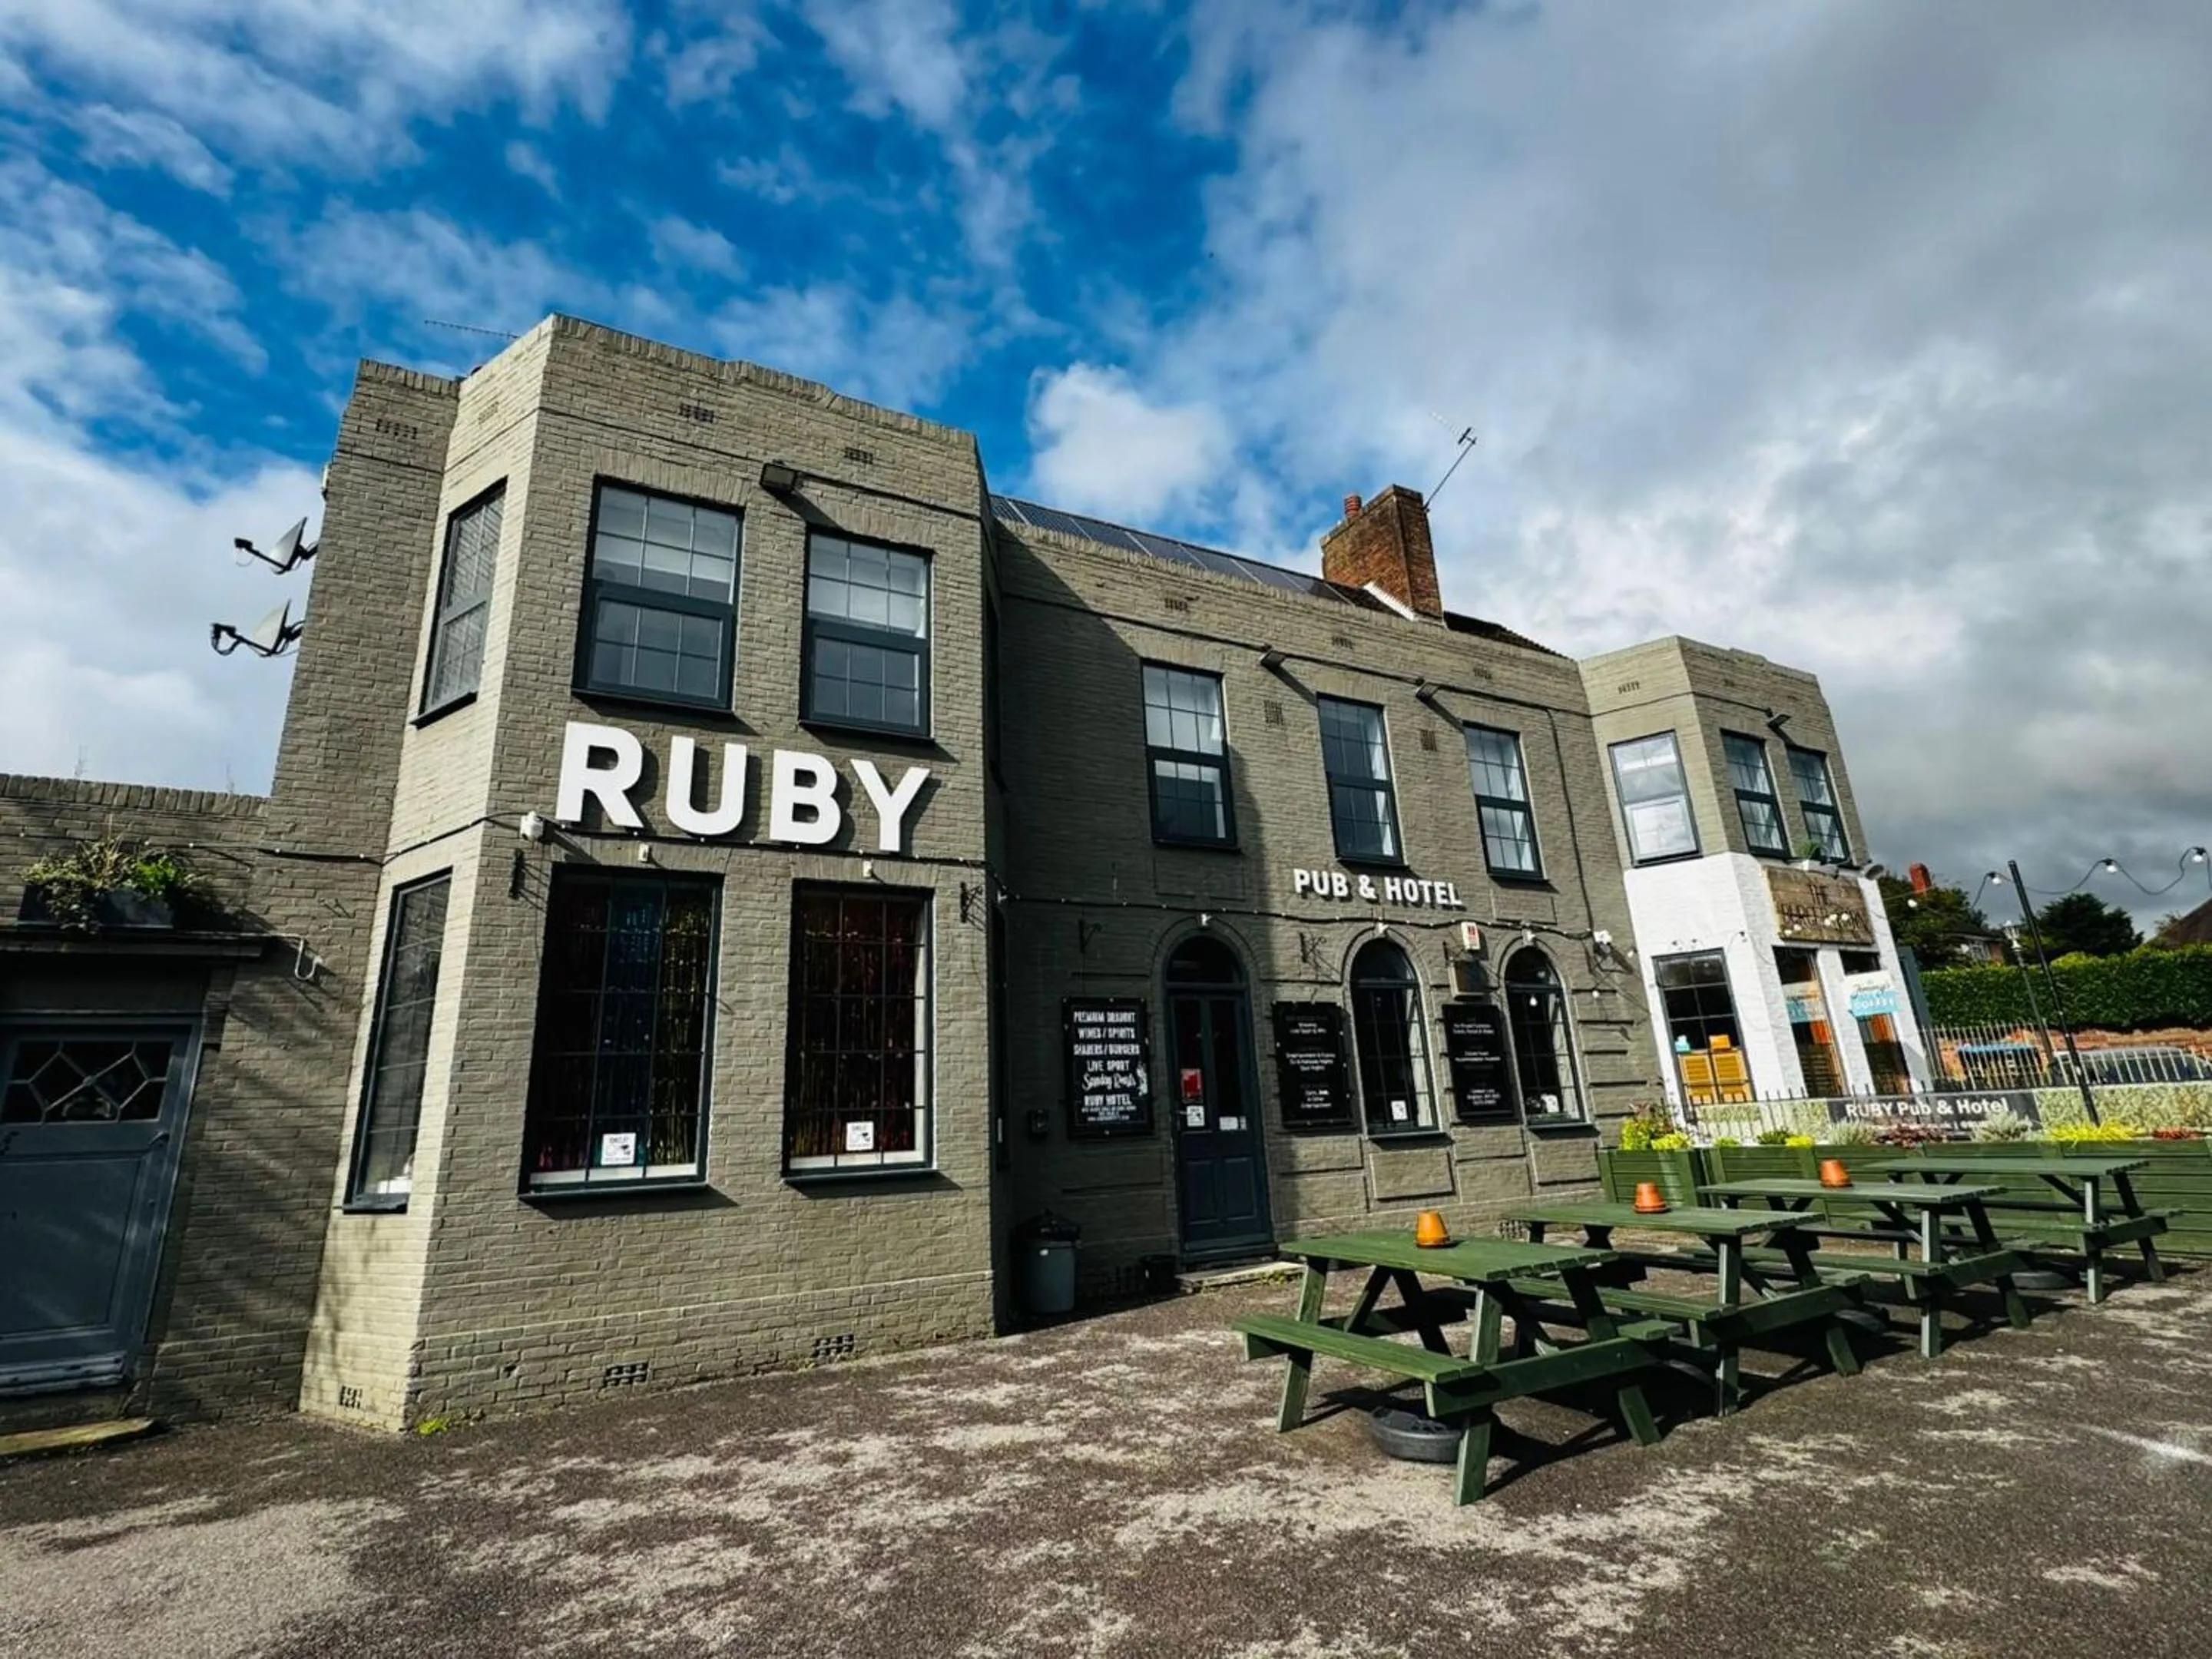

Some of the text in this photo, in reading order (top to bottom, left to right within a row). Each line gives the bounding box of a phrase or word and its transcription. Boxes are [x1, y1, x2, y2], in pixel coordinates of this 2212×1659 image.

[555, 720, 931, 853] RUBY
[1293, 868, 1463, 906] PUB & HOTEL
[1086, 1060, 1130, 1072] LIVE SPORT
[1081, 1072, 1112, 1091] Sunday
[1846, 1097, 2009, 1117] RUBY Pub & Hotel
